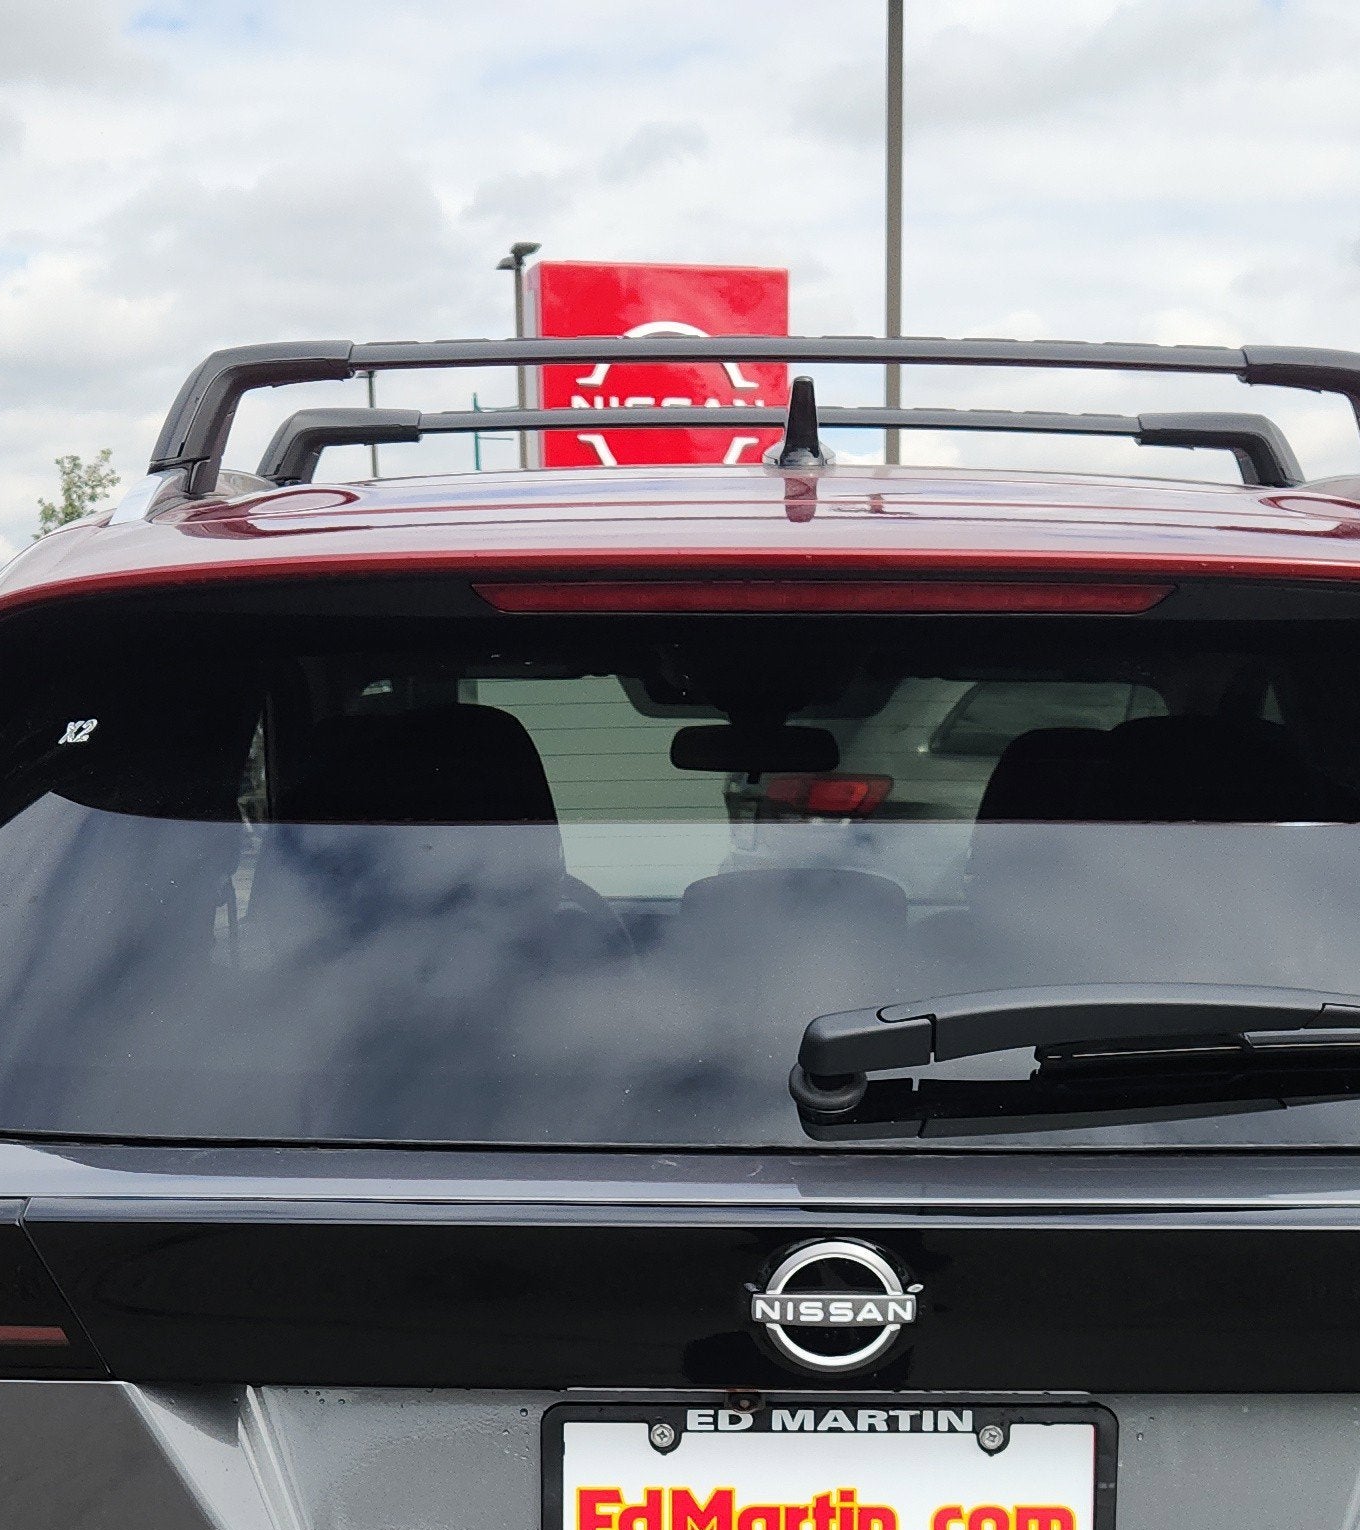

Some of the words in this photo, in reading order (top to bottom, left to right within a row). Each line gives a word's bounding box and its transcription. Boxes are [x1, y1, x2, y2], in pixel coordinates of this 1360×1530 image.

[754, 1298, 915, 1323] NISSAN
[685, 1409, 755, 1432] ED
[771, 1409, 974, 1432] MARTIN
